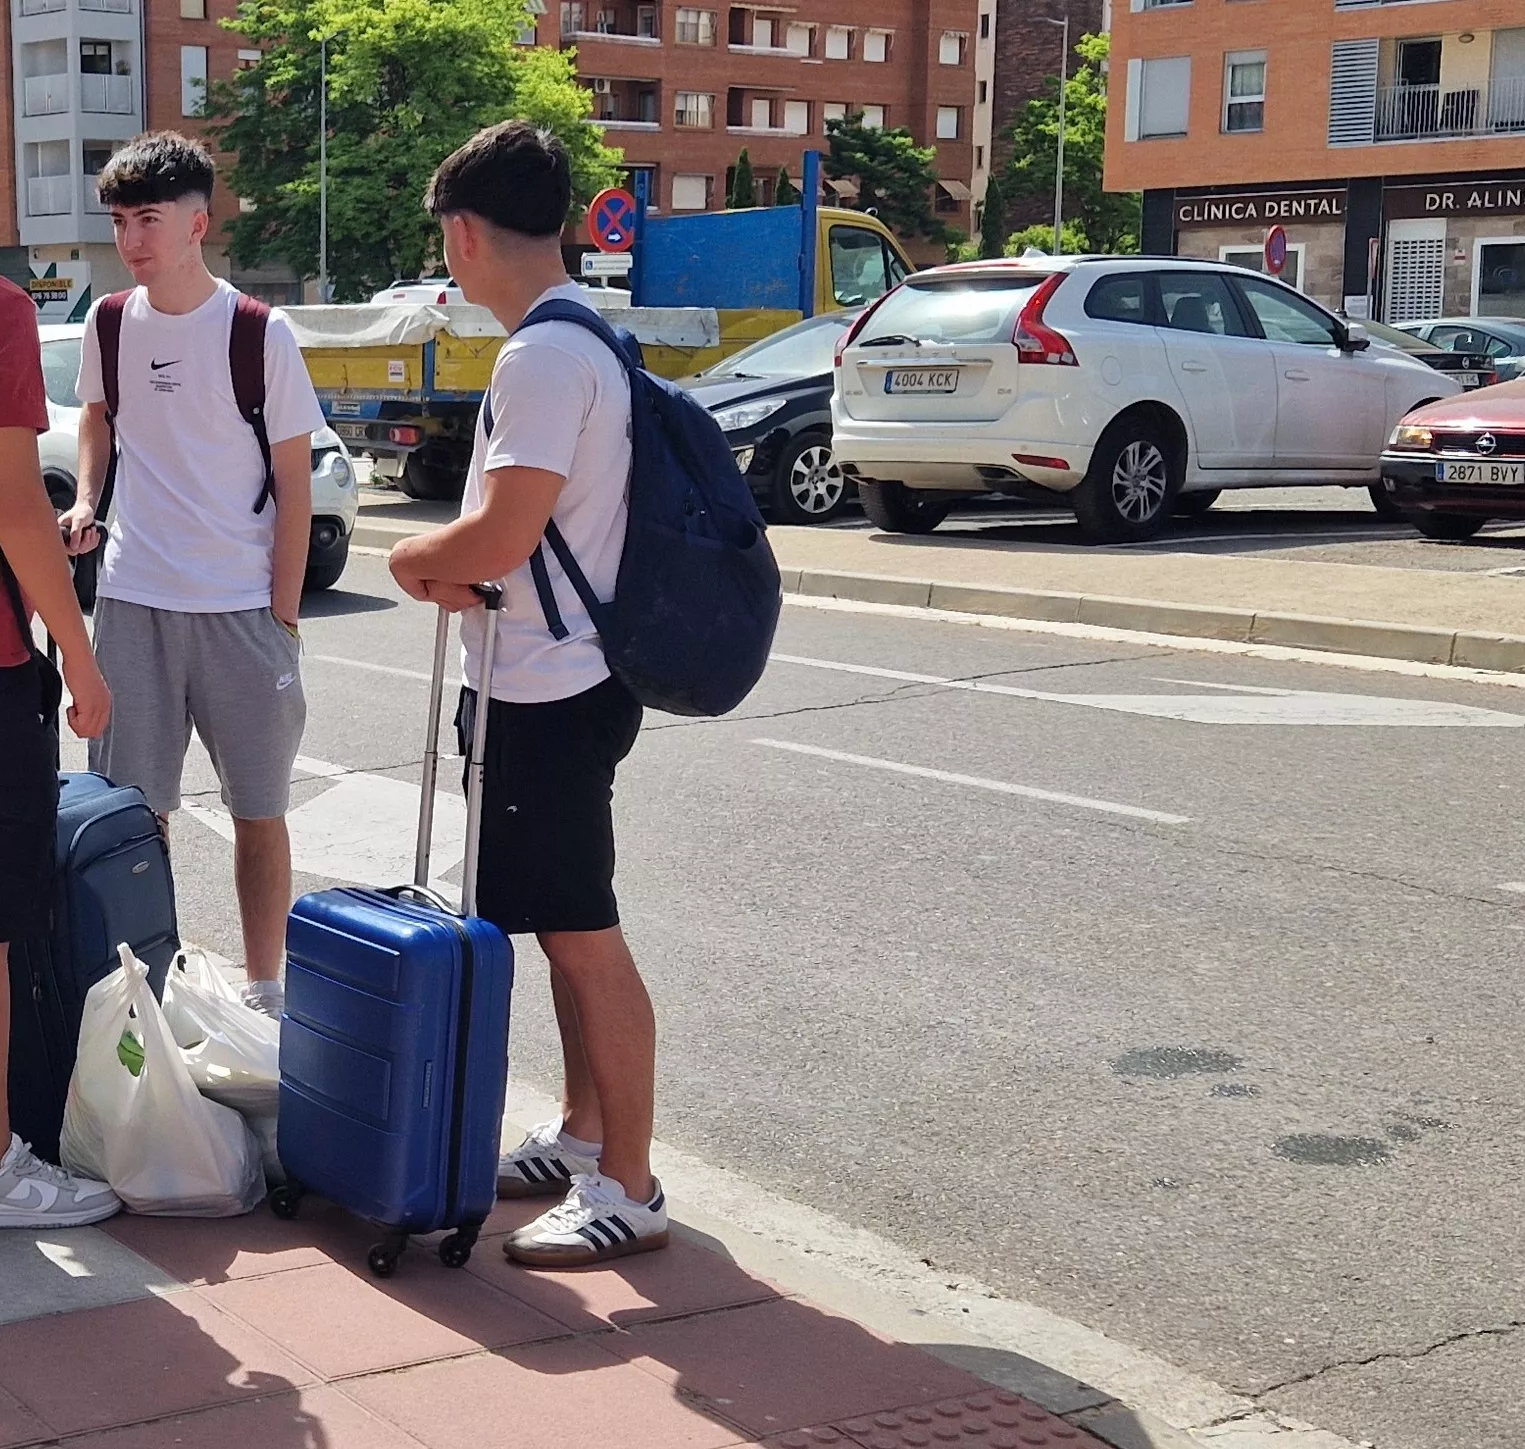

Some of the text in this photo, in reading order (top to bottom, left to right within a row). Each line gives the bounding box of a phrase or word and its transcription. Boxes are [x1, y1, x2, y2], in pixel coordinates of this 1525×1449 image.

[1179, 197, 1342, 222] CLÍNICA DENTAL
[1425, 189, 1525, 211] DR. ALIN
[894, 372, 953, 387] 4004 KCK
[1448, 465, 1519, 482] 2871 BVY
